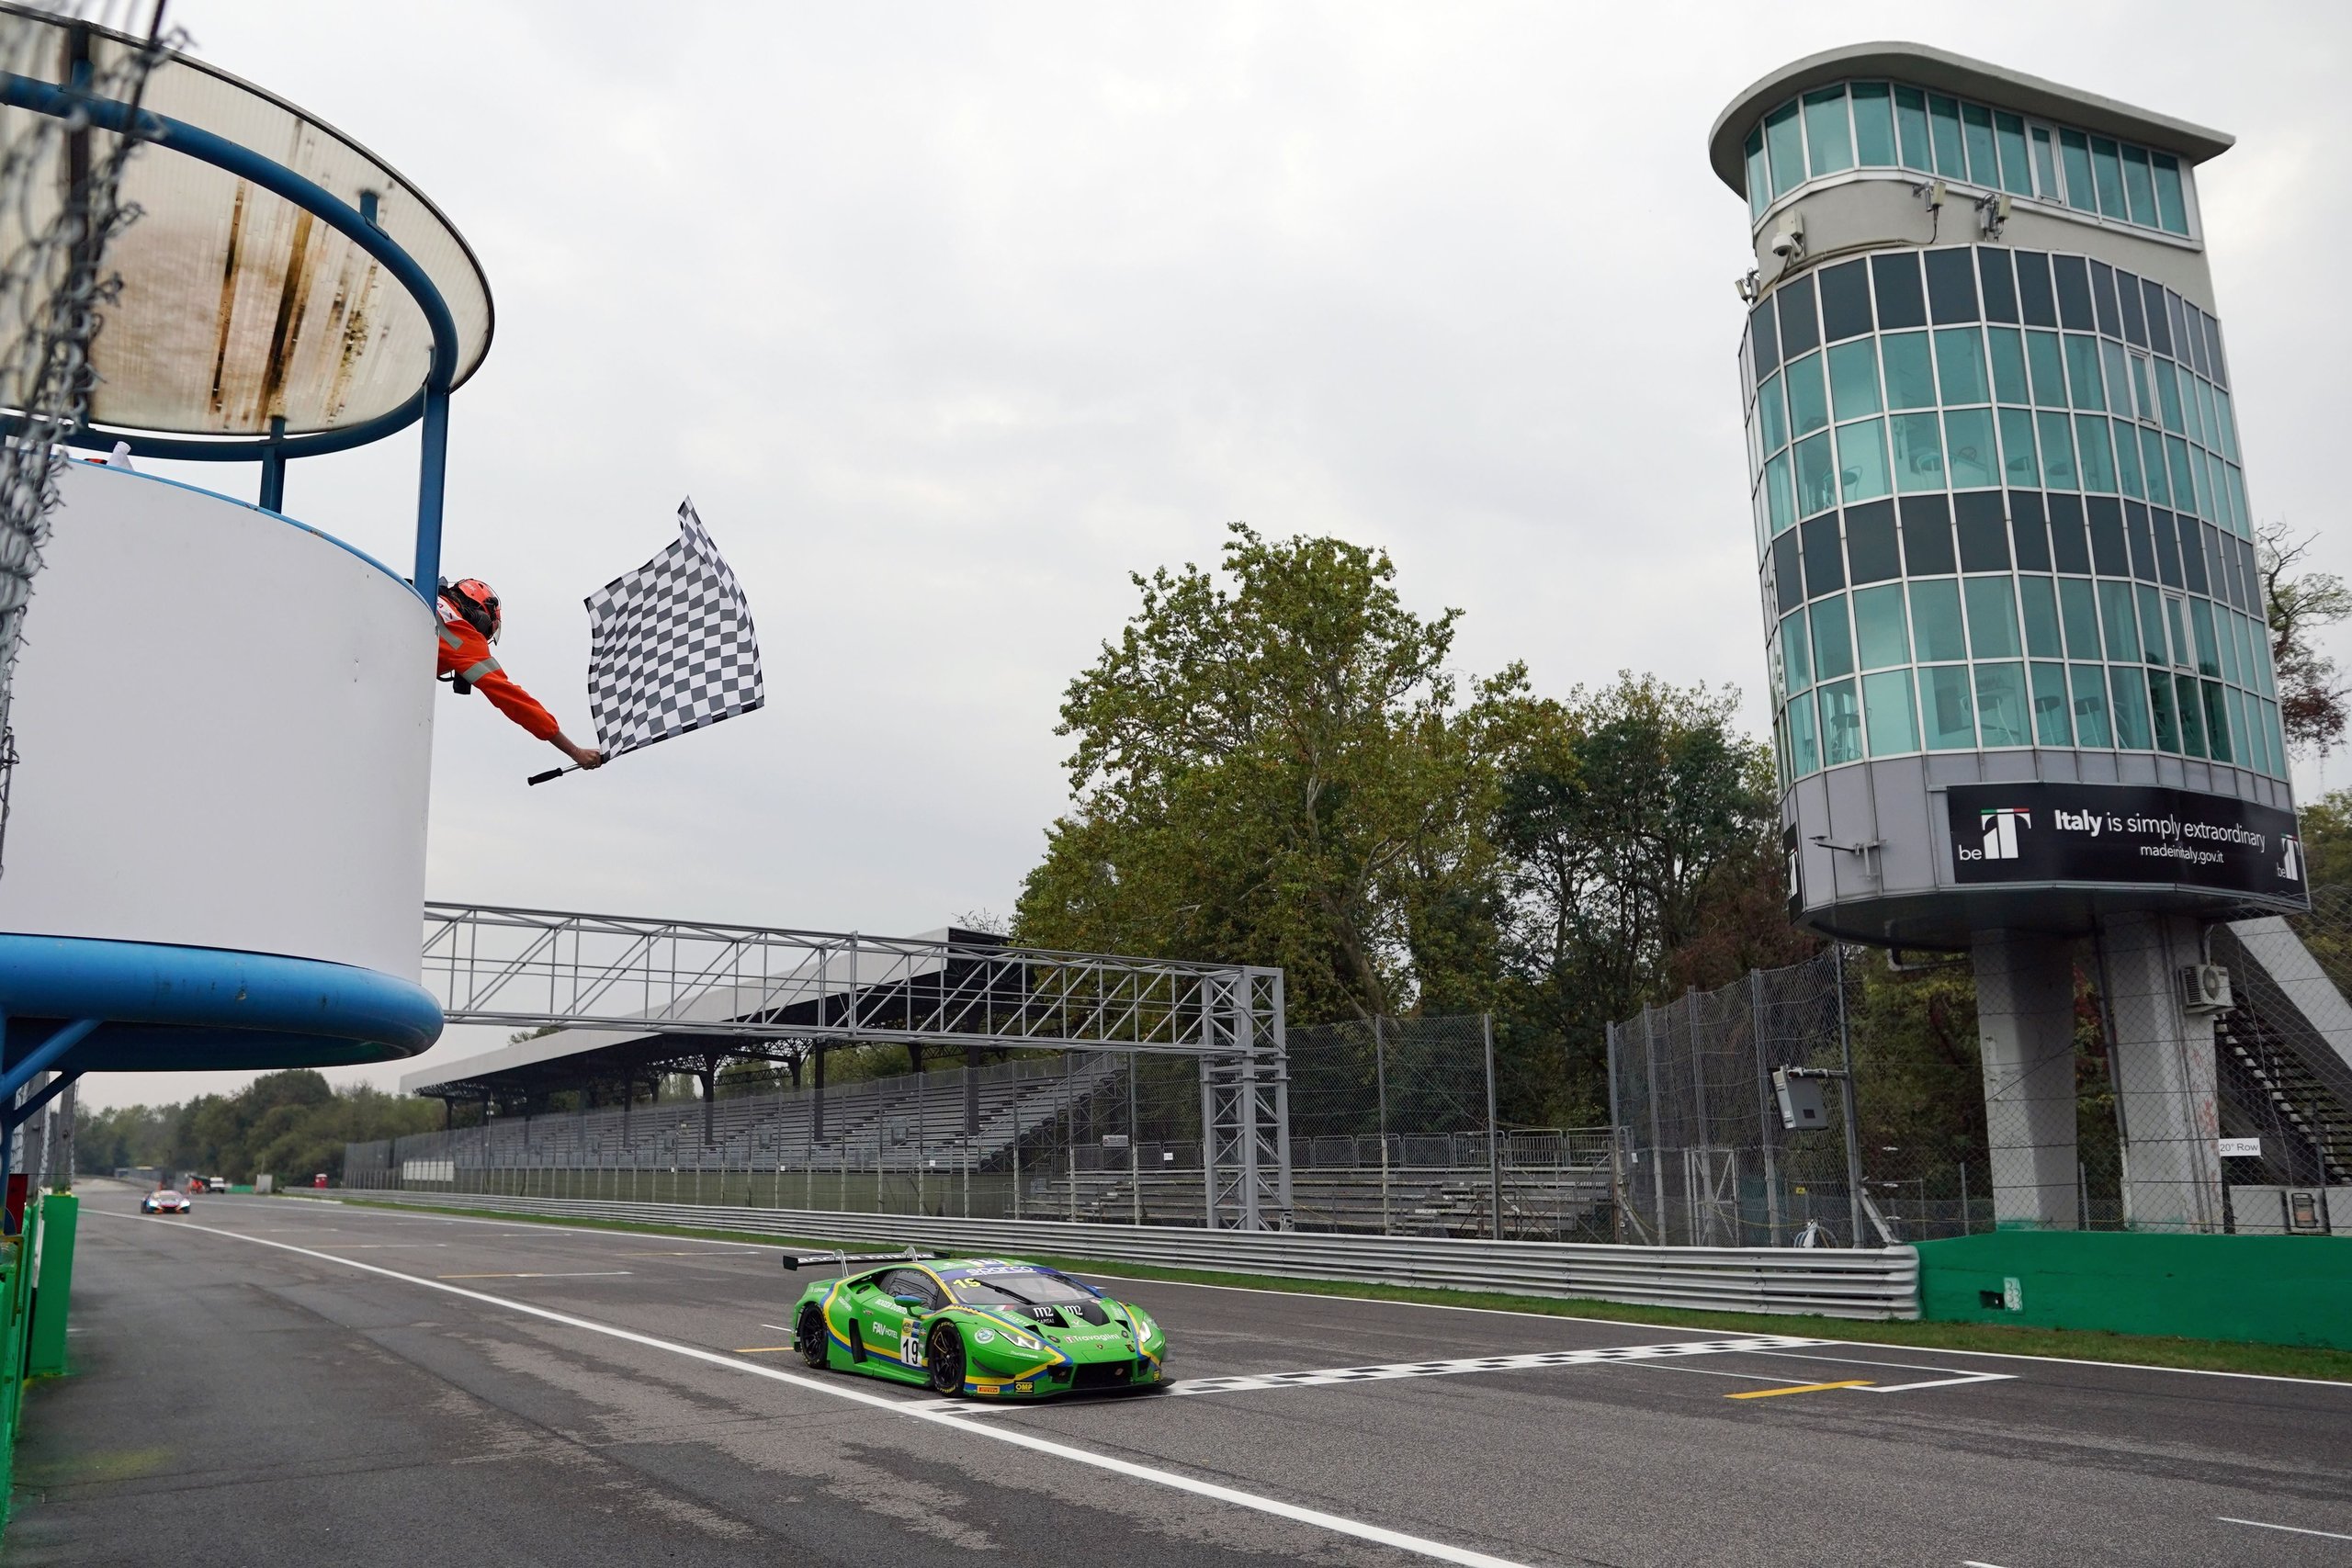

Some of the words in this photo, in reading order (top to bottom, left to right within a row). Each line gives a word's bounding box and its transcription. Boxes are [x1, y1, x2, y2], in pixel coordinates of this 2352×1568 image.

[1959, 844, 1983, 861] be
[2054, 807, 2103, 837] Italy
[2106, 812, 2123, 832] is
[2127, 813, 2181, 841] simply
[2184, 823, 2266, 853] extraordinary
[2141, 843, 2224, 864] madeinitaly.gov.it
[2236, 1143, 2259, 1151] Row
[966, 1266, 1035, 1276] sparco
[873, 1321, 887, 1336] FAV
[885, 1327, 899, 1339] HOTEL
[1072, 1334, 1121, 1342] Travaglini
[902, 1338, 920, 1365] 19
